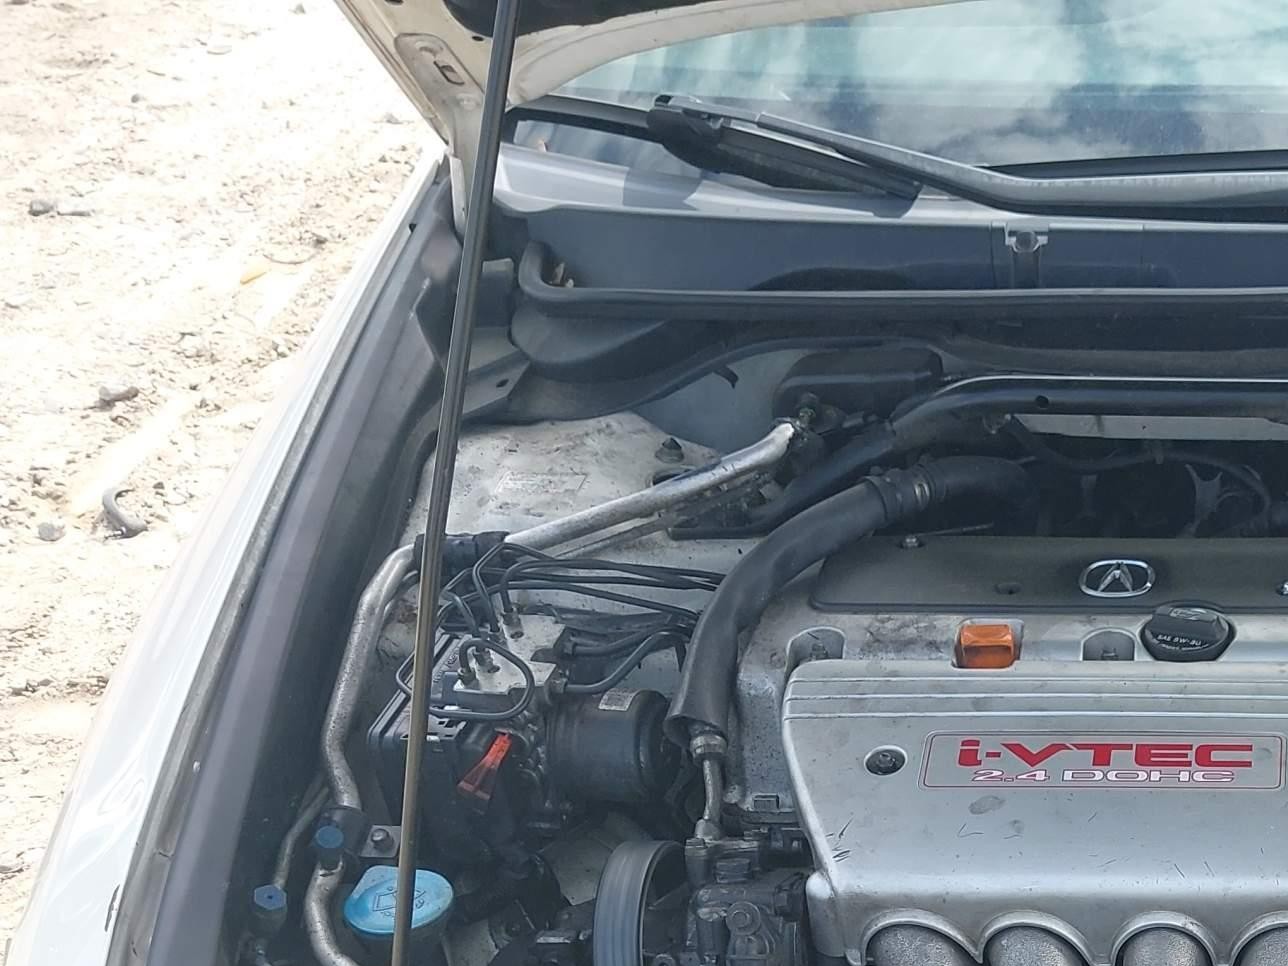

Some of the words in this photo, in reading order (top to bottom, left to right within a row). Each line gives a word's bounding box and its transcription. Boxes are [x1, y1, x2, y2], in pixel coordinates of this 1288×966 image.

[958, 739, 1253, 768] i-VTEC
[971, 769, 1050, 782] 2.4
[1062, 769, 1235, 783] DOHC
